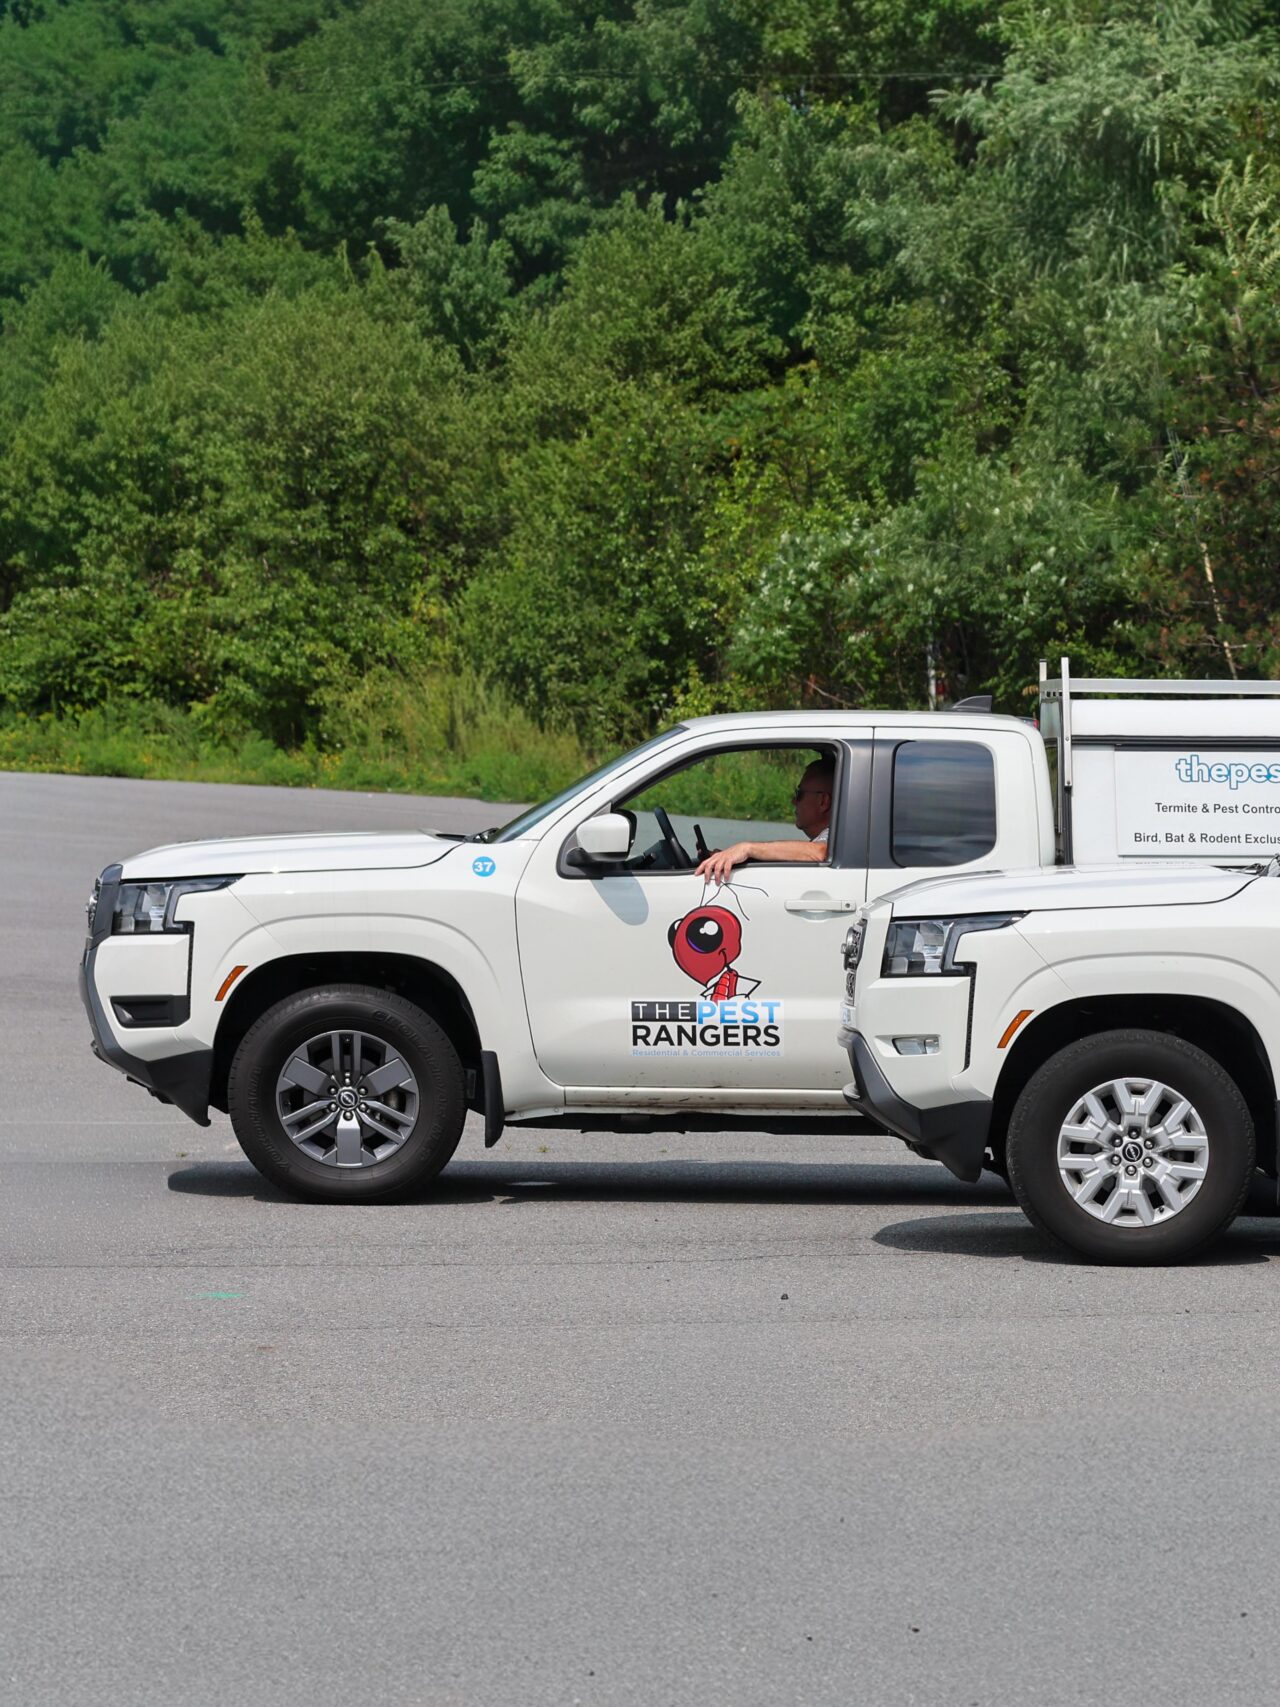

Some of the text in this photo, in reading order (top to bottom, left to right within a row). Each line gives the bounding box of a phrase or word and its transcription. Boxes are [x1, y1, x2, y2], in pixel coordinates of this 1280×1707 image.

[1154, 802, 1198, 814] Termite
[1201, 803, 1210, 814] &
[1213, 803, 1239, 814] Pest
[1134, 832, 1161, 844] Bird,
[1165, 833, 1185, 844] Bat
[1188, 833, 1197, 844] &
[1200, 833, 1242, 844] Rodent
[475, 861, 493, 873] 37
[633, 1001, 781, 1024] THE PEST
[632, 1024, 781, 1047] RANGERS
[632, 1049, 781, 1057] Residential & Commercial Services
